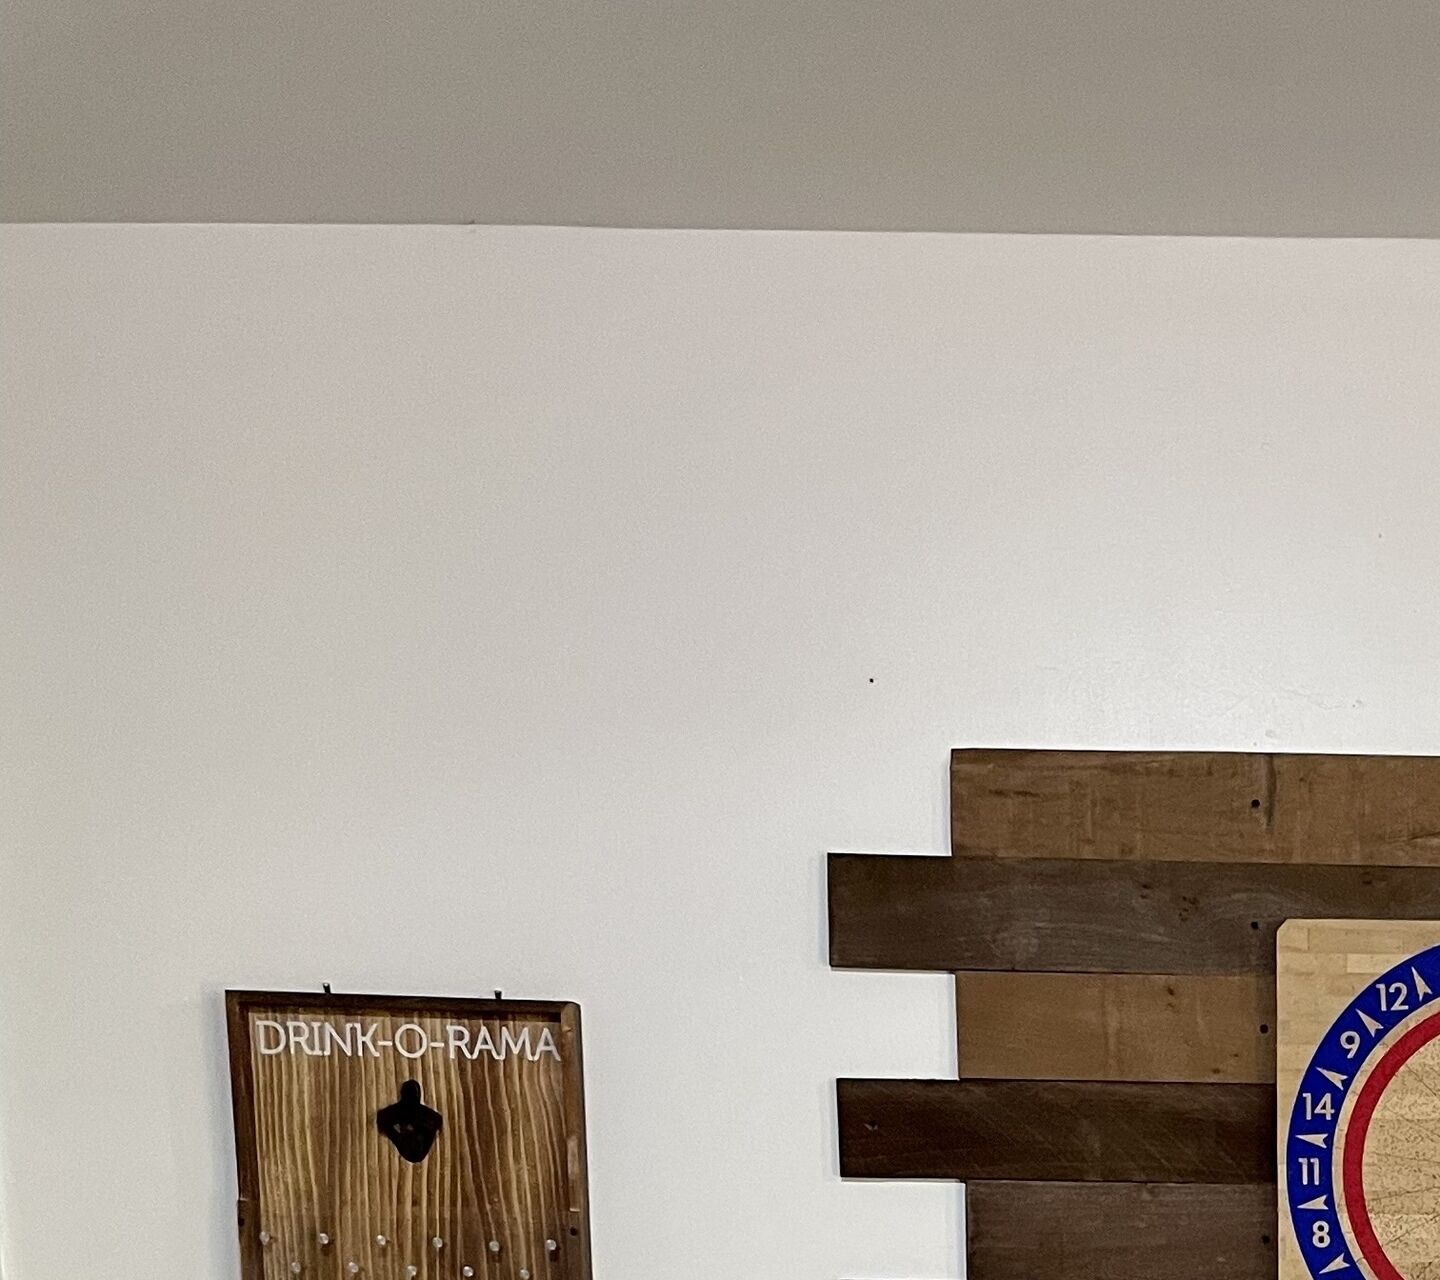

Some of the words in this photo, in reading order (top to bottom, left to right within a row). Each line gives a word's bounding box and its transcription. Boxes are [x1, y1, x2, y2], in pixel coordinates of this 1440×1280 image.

[1375, 982, 1409, 1012] 12
[255, 1019, 562, 1062] DRINK-O-RAMA
[1339, 1030, 1361, 1059] 9
[1302, 1092, 1335, 1121] 14
[1298, 1157, 1320, 1186] 11
[1312, 1220, 1331, 1248] 8
